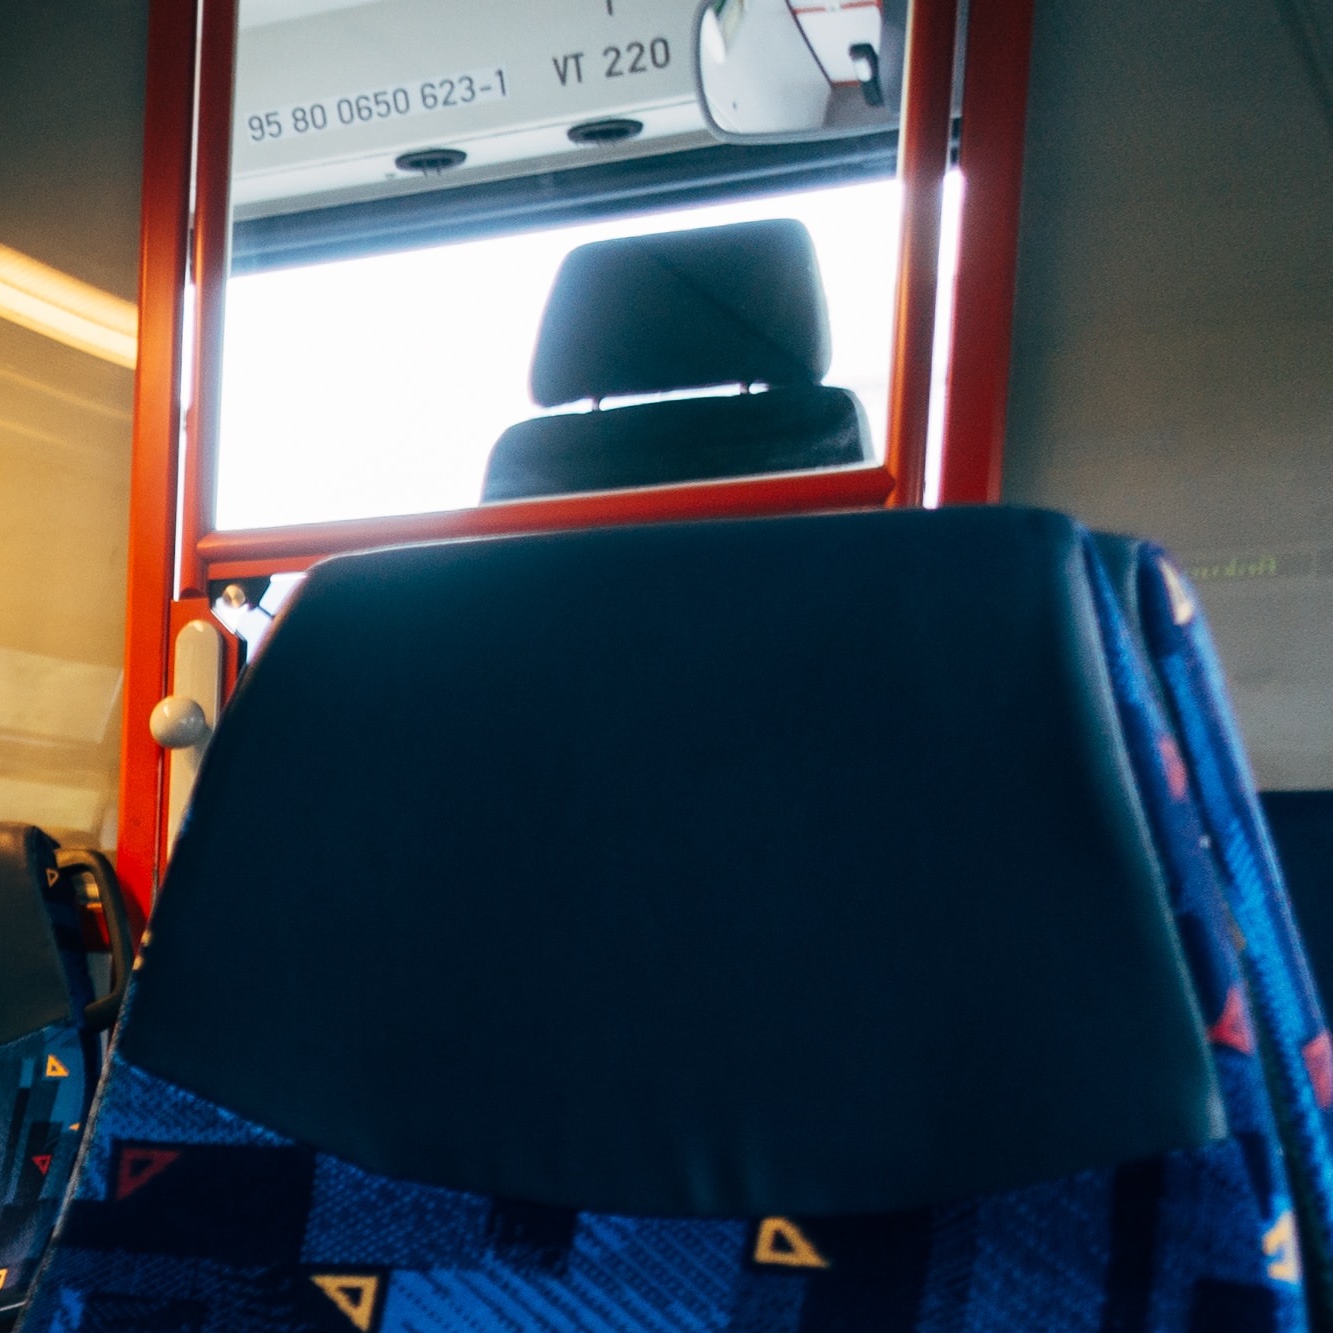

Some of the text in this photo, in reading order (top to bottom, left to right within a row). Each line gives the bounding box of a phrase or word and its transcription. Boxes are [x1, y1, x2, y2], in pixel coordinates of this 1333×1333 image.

[552, 36, 672, 87] VT 220
[247, 68, 509, 142] 95 80 0650 623-1
